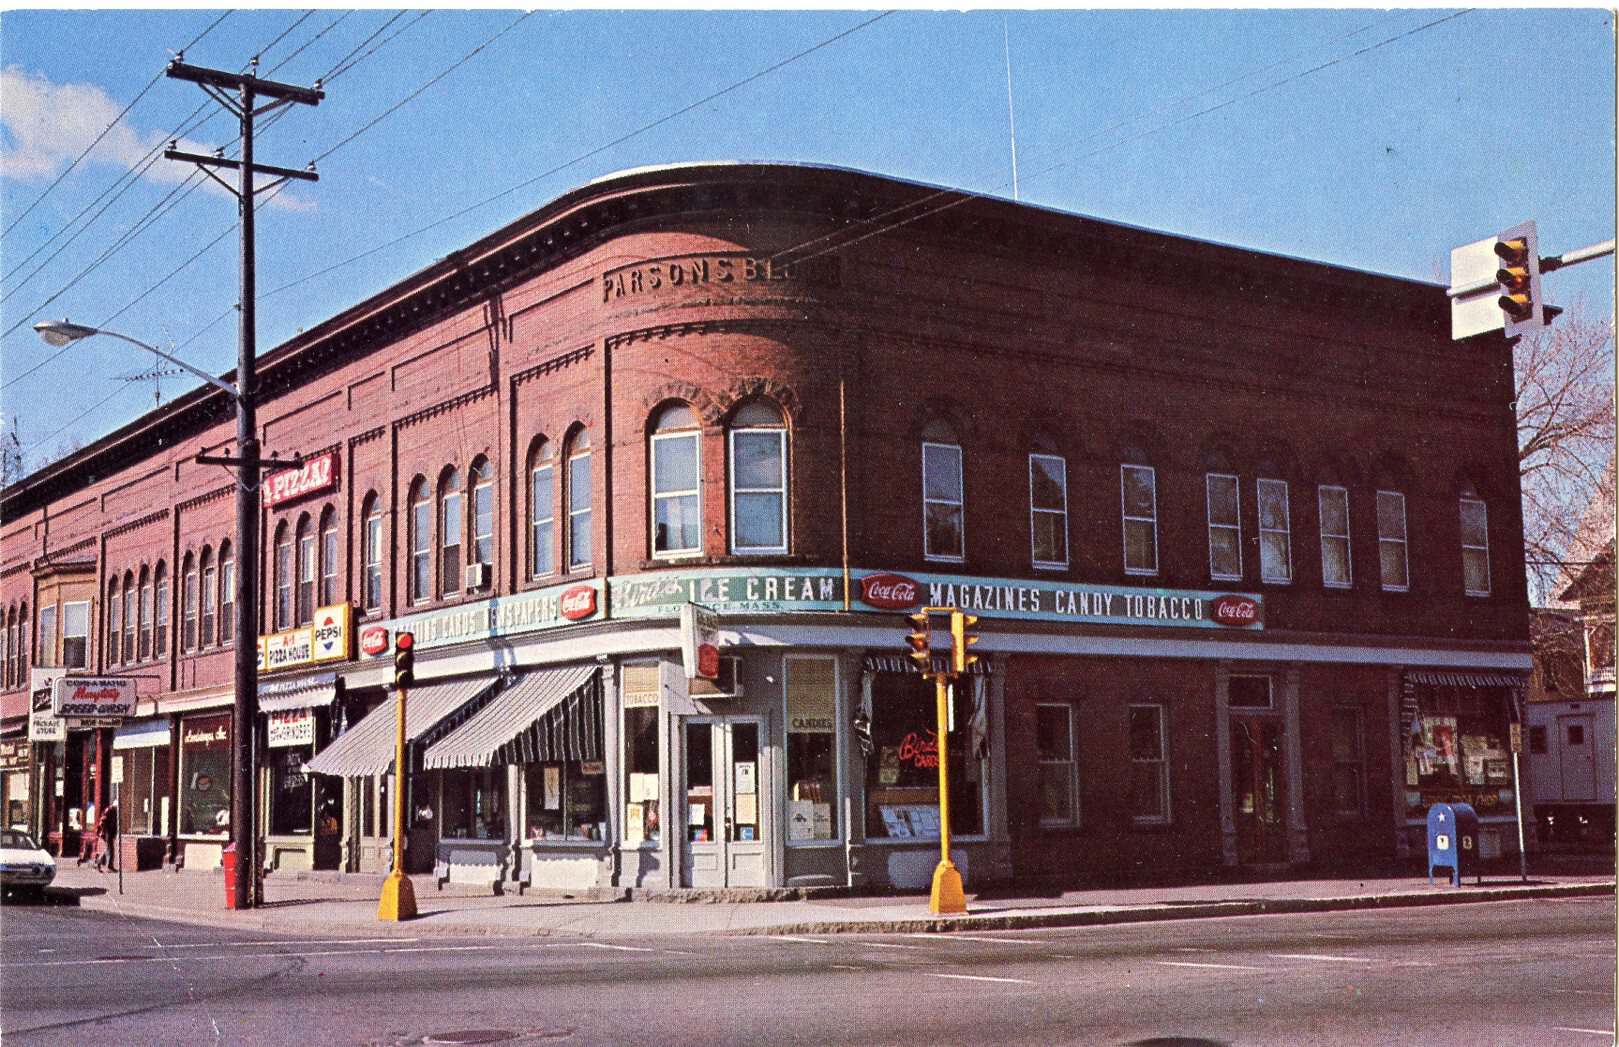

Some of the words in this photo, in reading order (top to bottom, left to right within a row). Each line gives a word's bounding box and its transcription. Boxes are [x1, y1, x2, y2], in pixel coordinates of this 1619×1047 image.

[603, 256, 735, 303] PARSONS
[689, 577, 730, 602] ICE
[747, 576, 834, 601] CREAM
[929, 582, 1041, 613] MAGAZINES
[1055, 589, 1113, 617] CANDY
[1125, 594, 1203, 621] TOBACCO
[315, 625, 342, 641] PEPSI
[441, 610, 477, 640] CARDS
[269, 645, 288, 664] PIZZA
[625, 693, 659, 706] TOBACCO
